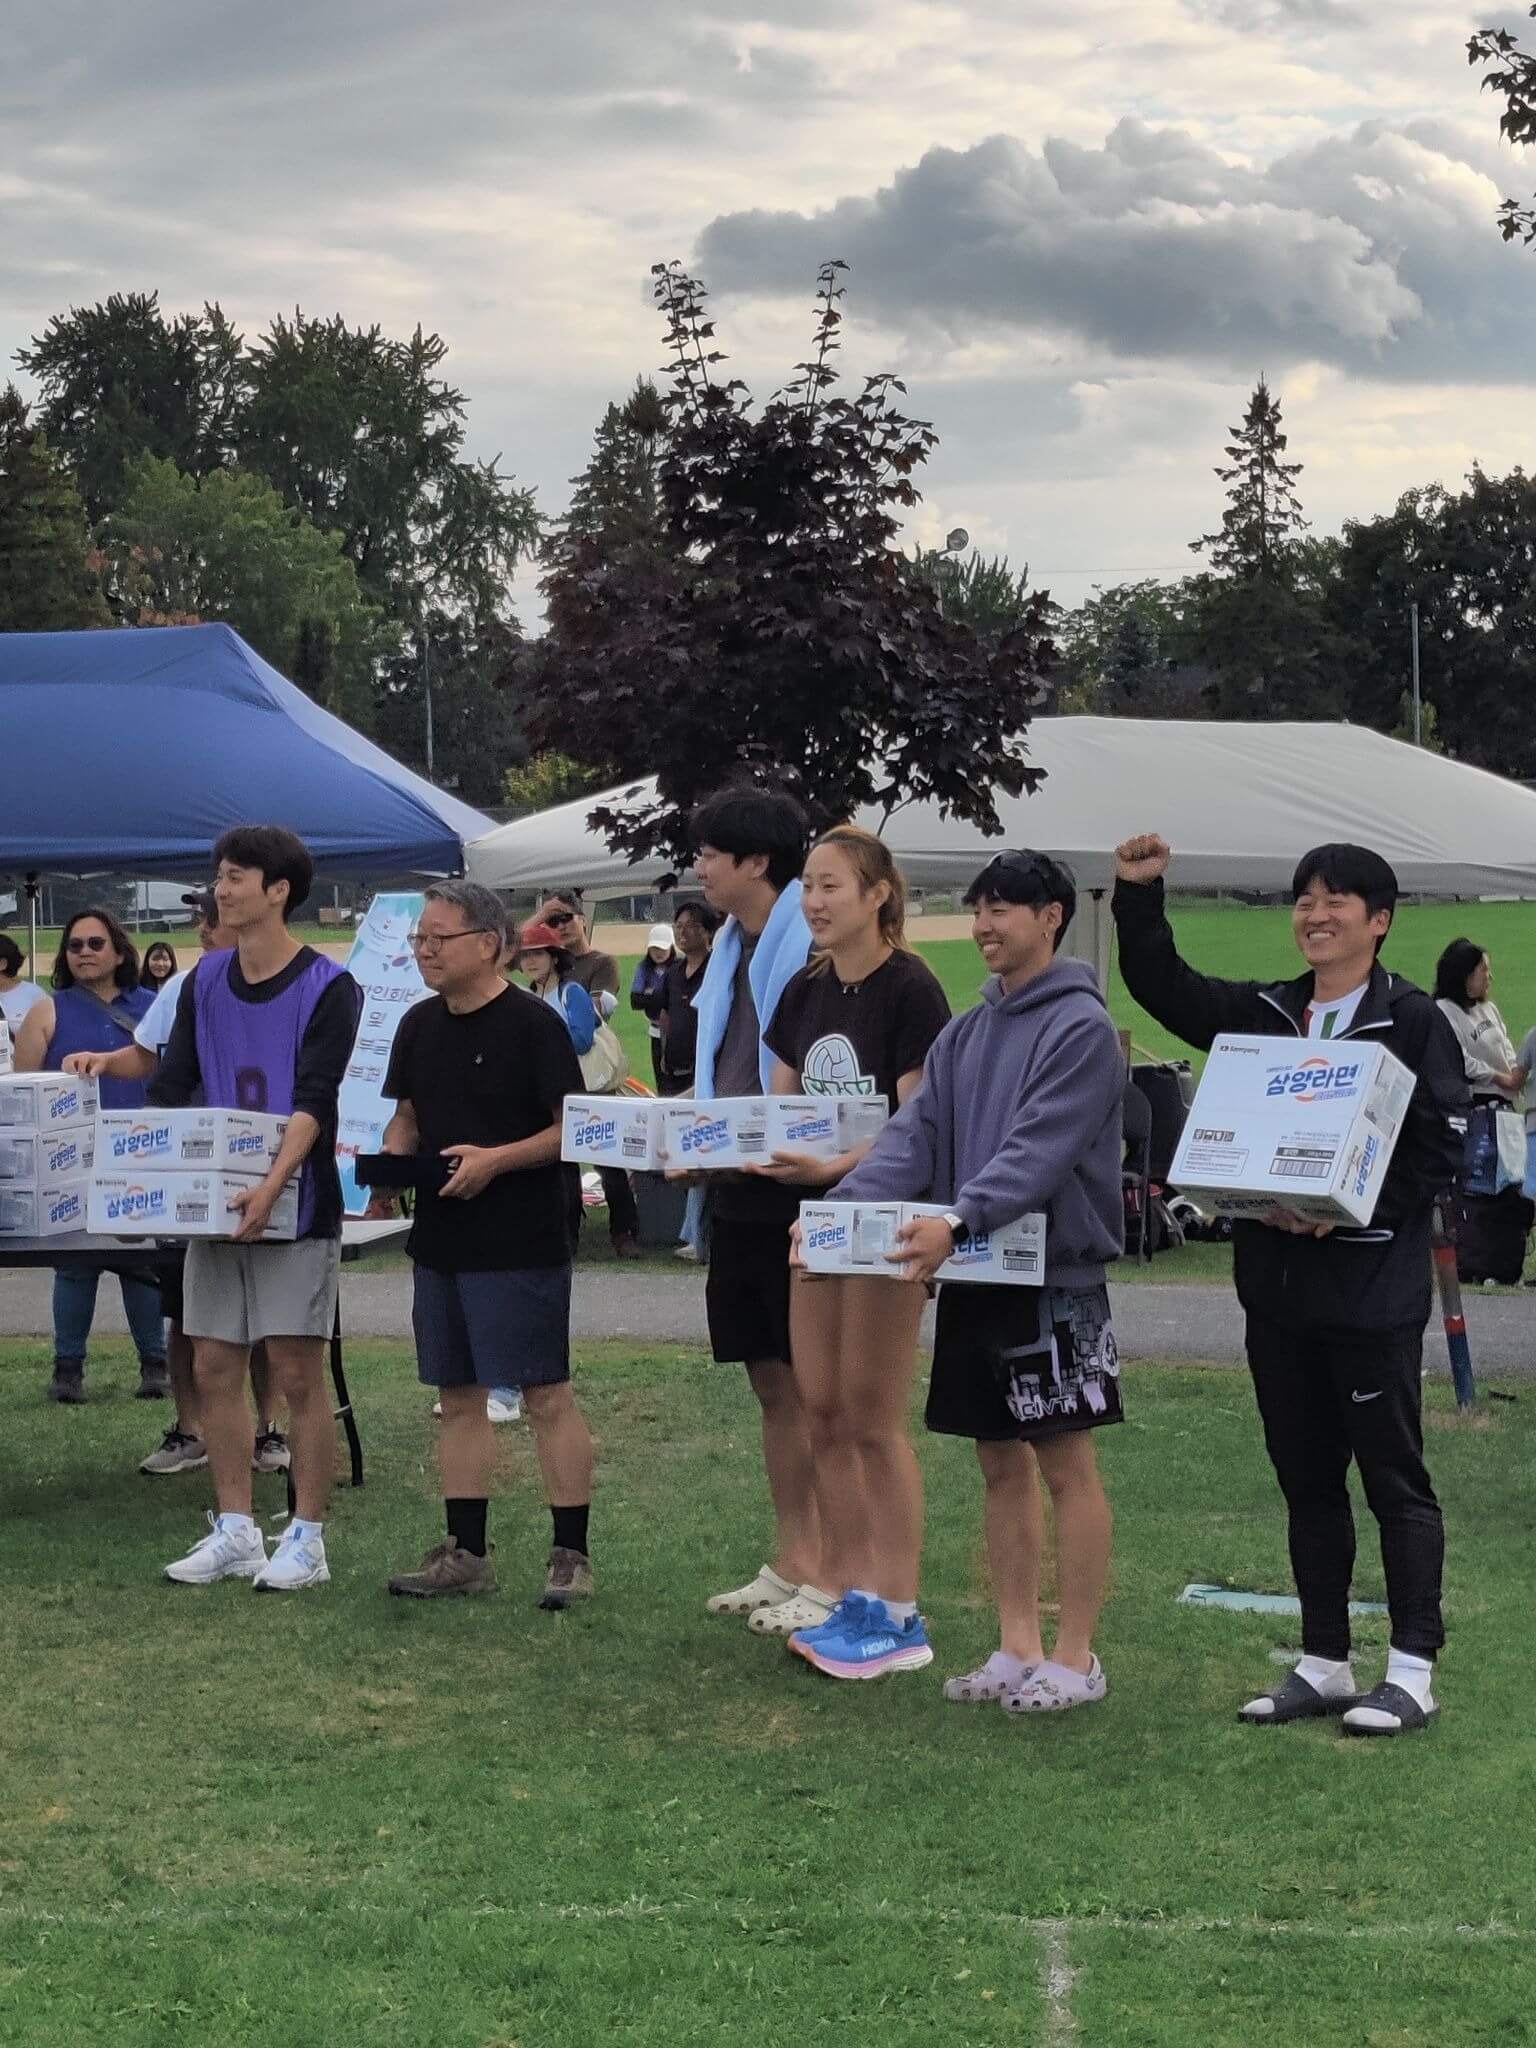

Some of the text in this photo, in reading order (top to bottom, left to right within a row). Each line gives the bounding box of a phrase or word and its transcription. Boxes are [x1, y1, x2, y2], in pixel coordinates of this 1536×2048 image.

[1266, 1064, 1359, 1097] 삼양라면
[113, 1126, 170, 1157] 삼양라면
[575, 1120, 616, 1147] 삼양라면
[808, 1226, 846, 1249] 삼양라면
[862, 1638, 896, 1657] HOKA
